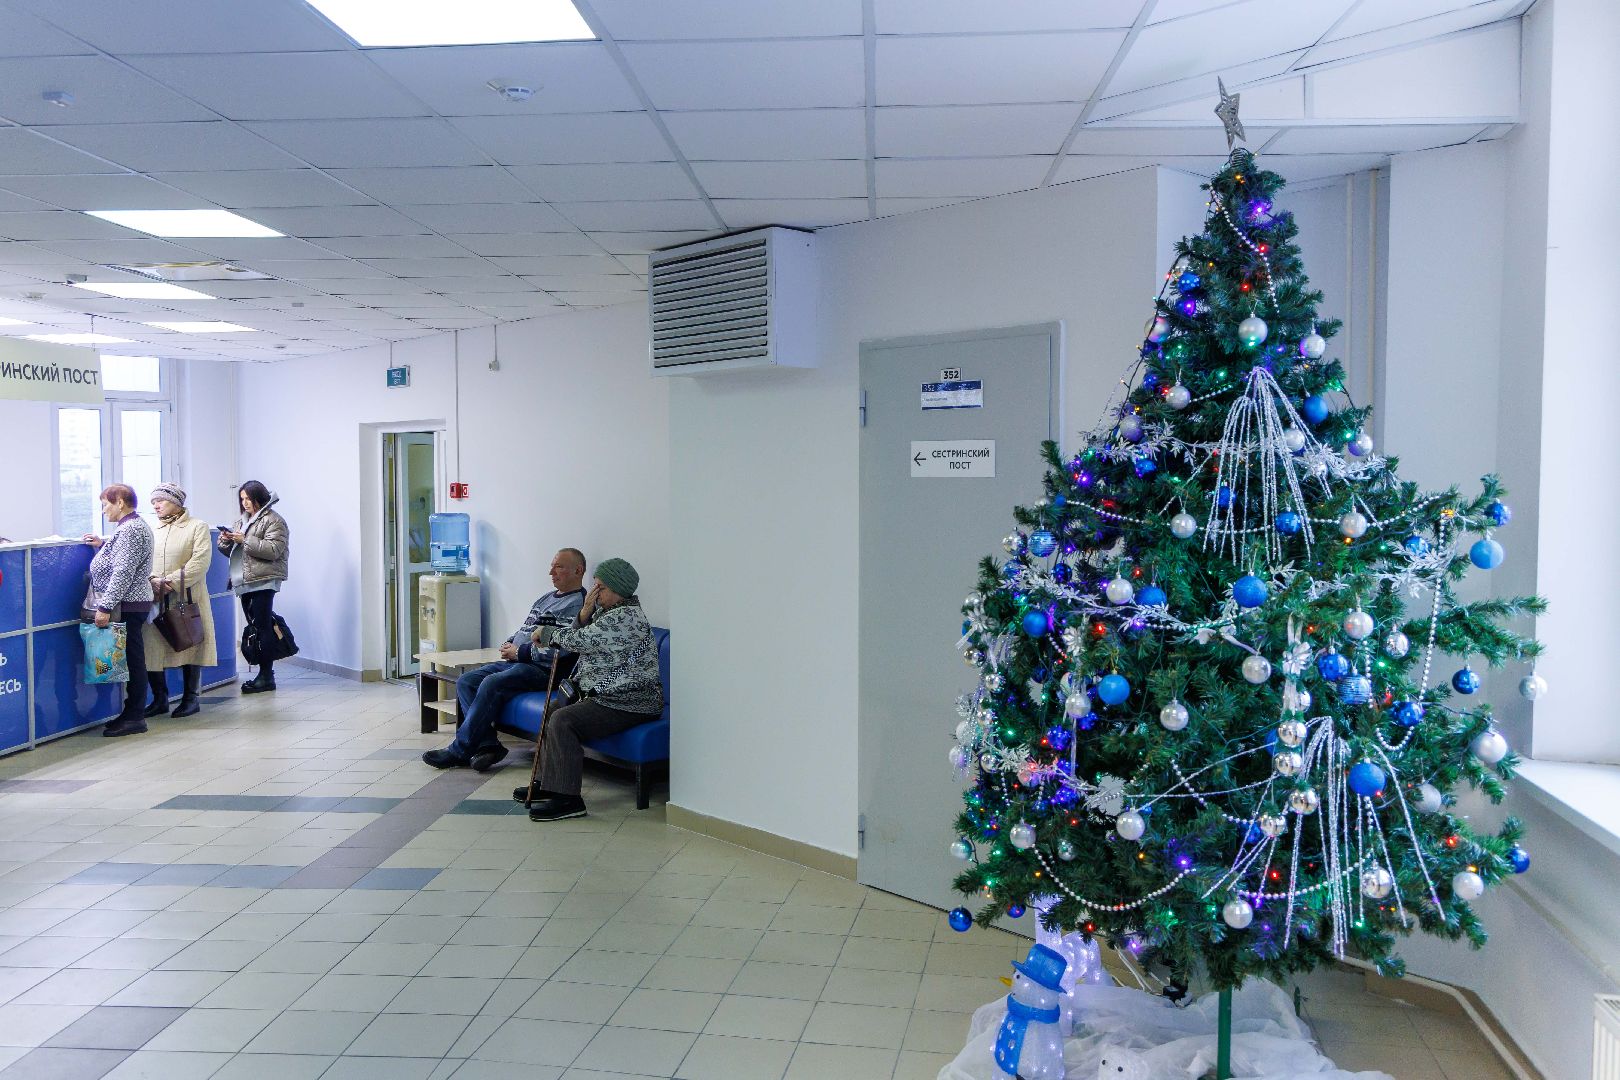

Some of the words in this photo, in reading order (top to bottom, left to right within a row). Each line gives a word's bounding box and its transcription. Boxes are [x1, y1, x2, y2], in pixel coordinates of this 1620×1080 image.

[0, 361, 60, 382] ИНСКИЙ
[63, 367, 98, 385] ПОСТ
[943, 370, 959, 379] 352
[931, 447, 990, 458] СЕСТРИНСКИЙ
[949, 461, 971, 470] ПОСТ
